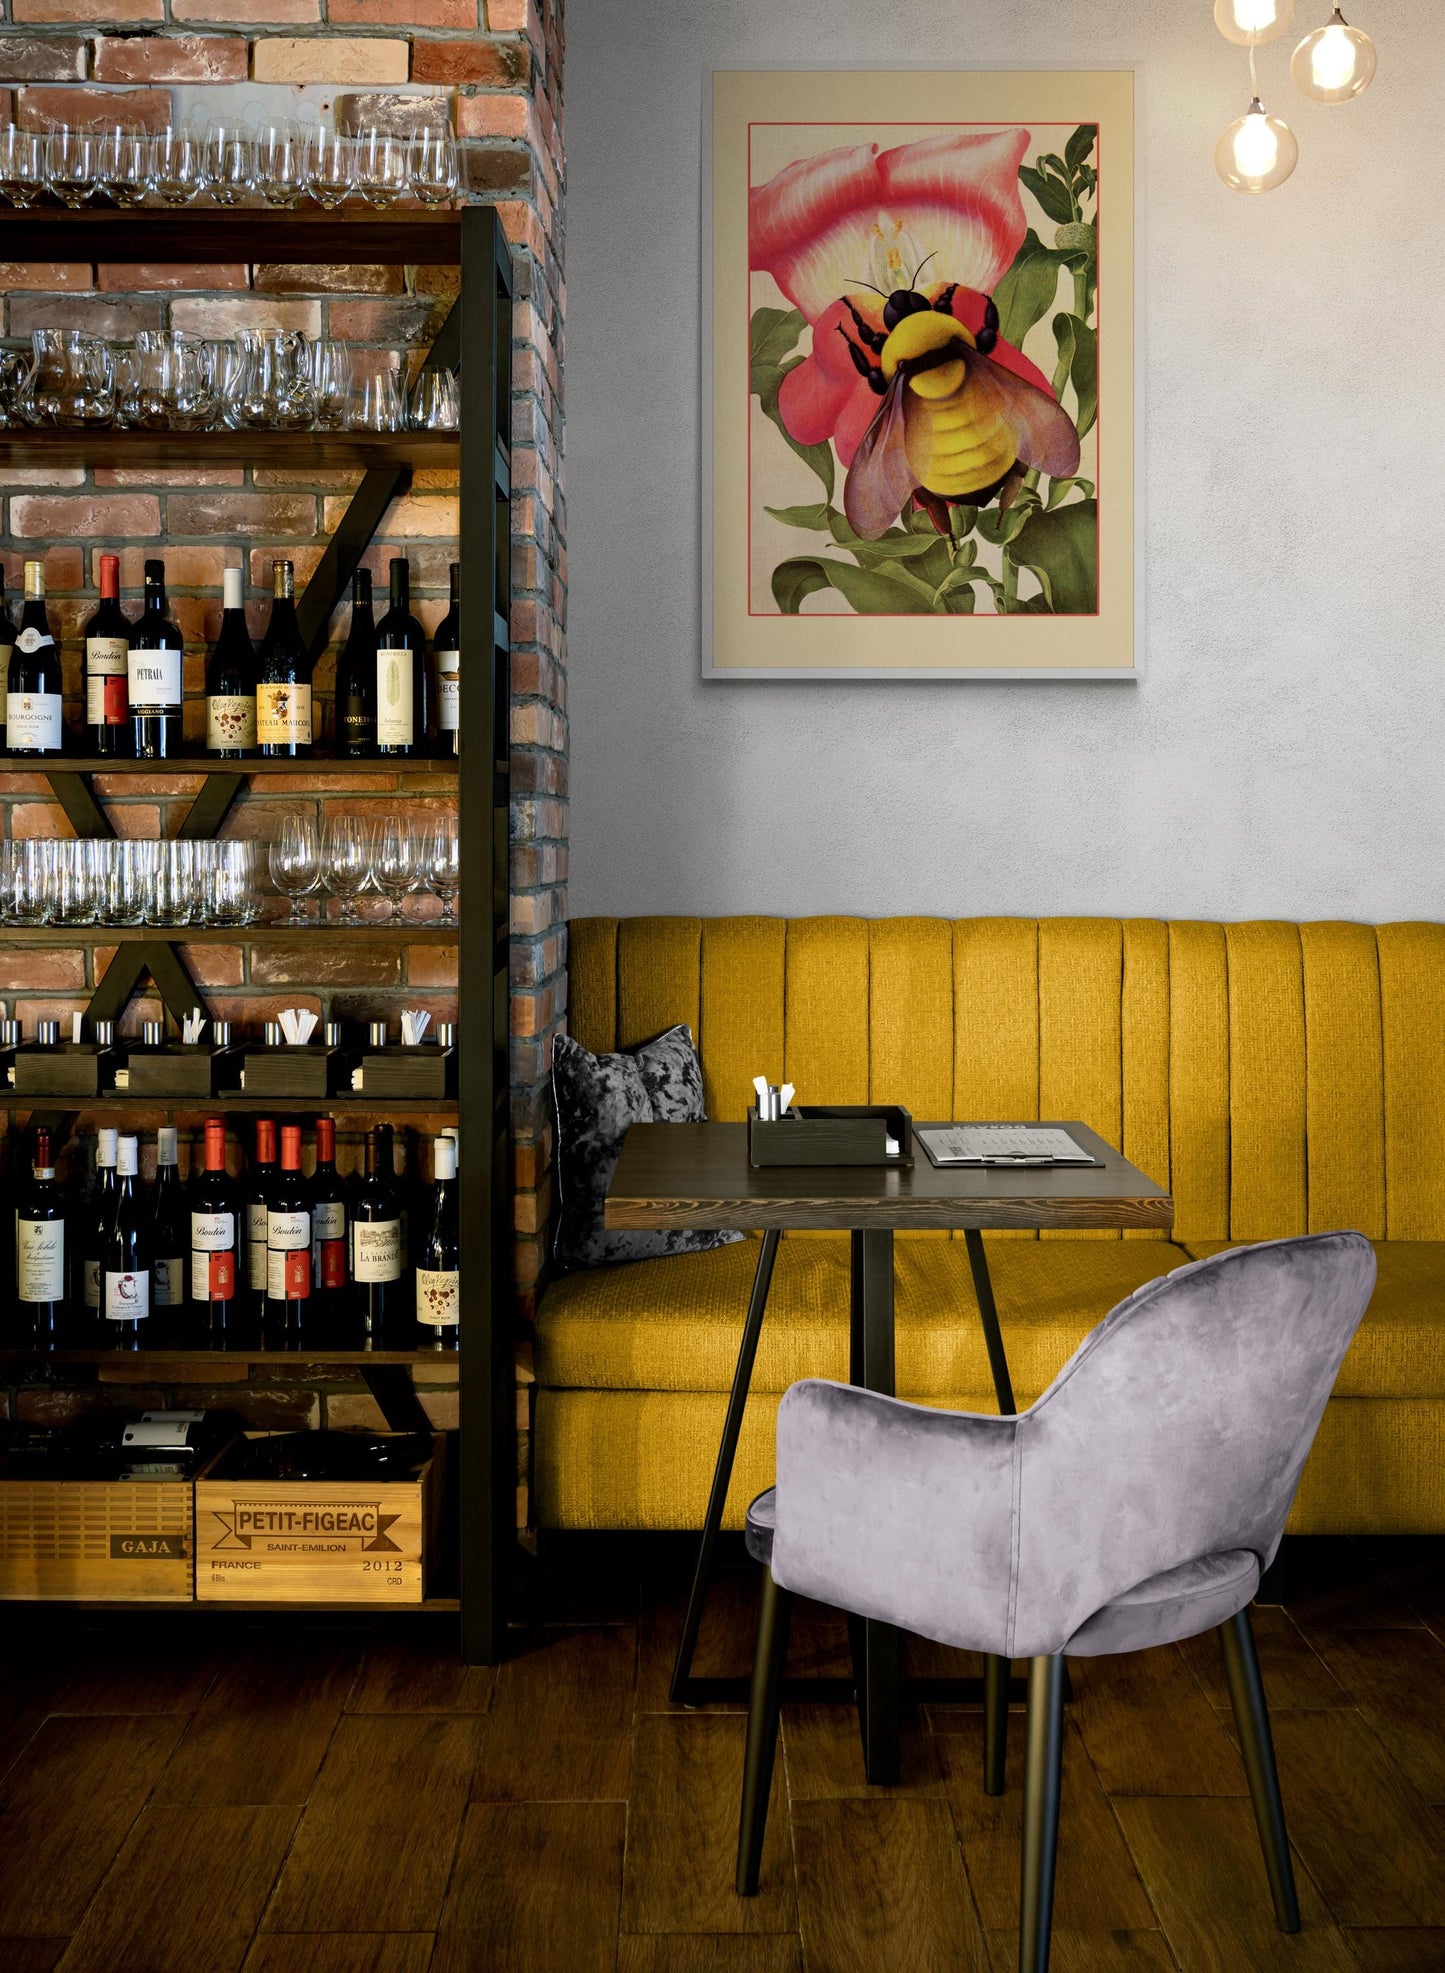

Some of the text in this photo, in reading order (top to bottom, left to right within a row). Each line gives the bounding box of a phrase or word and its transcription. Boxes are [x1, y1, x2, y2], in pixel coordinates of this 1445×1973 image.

[90, 651, 121, 660] Bordón
[137, 668, 163, 680] PETRAIA
[196, 1226, 226, 1236] Bordón
[272, 1225, 302, 1235] Bordón
[360, 1251, 370, 1262] LA
[372, 1249, 399, 1262] BRANDE
[239, 1511, 375, 1531] PETIT-FIGEAC
[121, 1540, 172, 1553] GAJA
[267, 1543, 346, 1553] SAINT-EMILION
[211, 1560, 262, 1569] FRANCE
[362, 1560, 403, 1571] 2012
[387, 1577, 403, 1585] CRD
